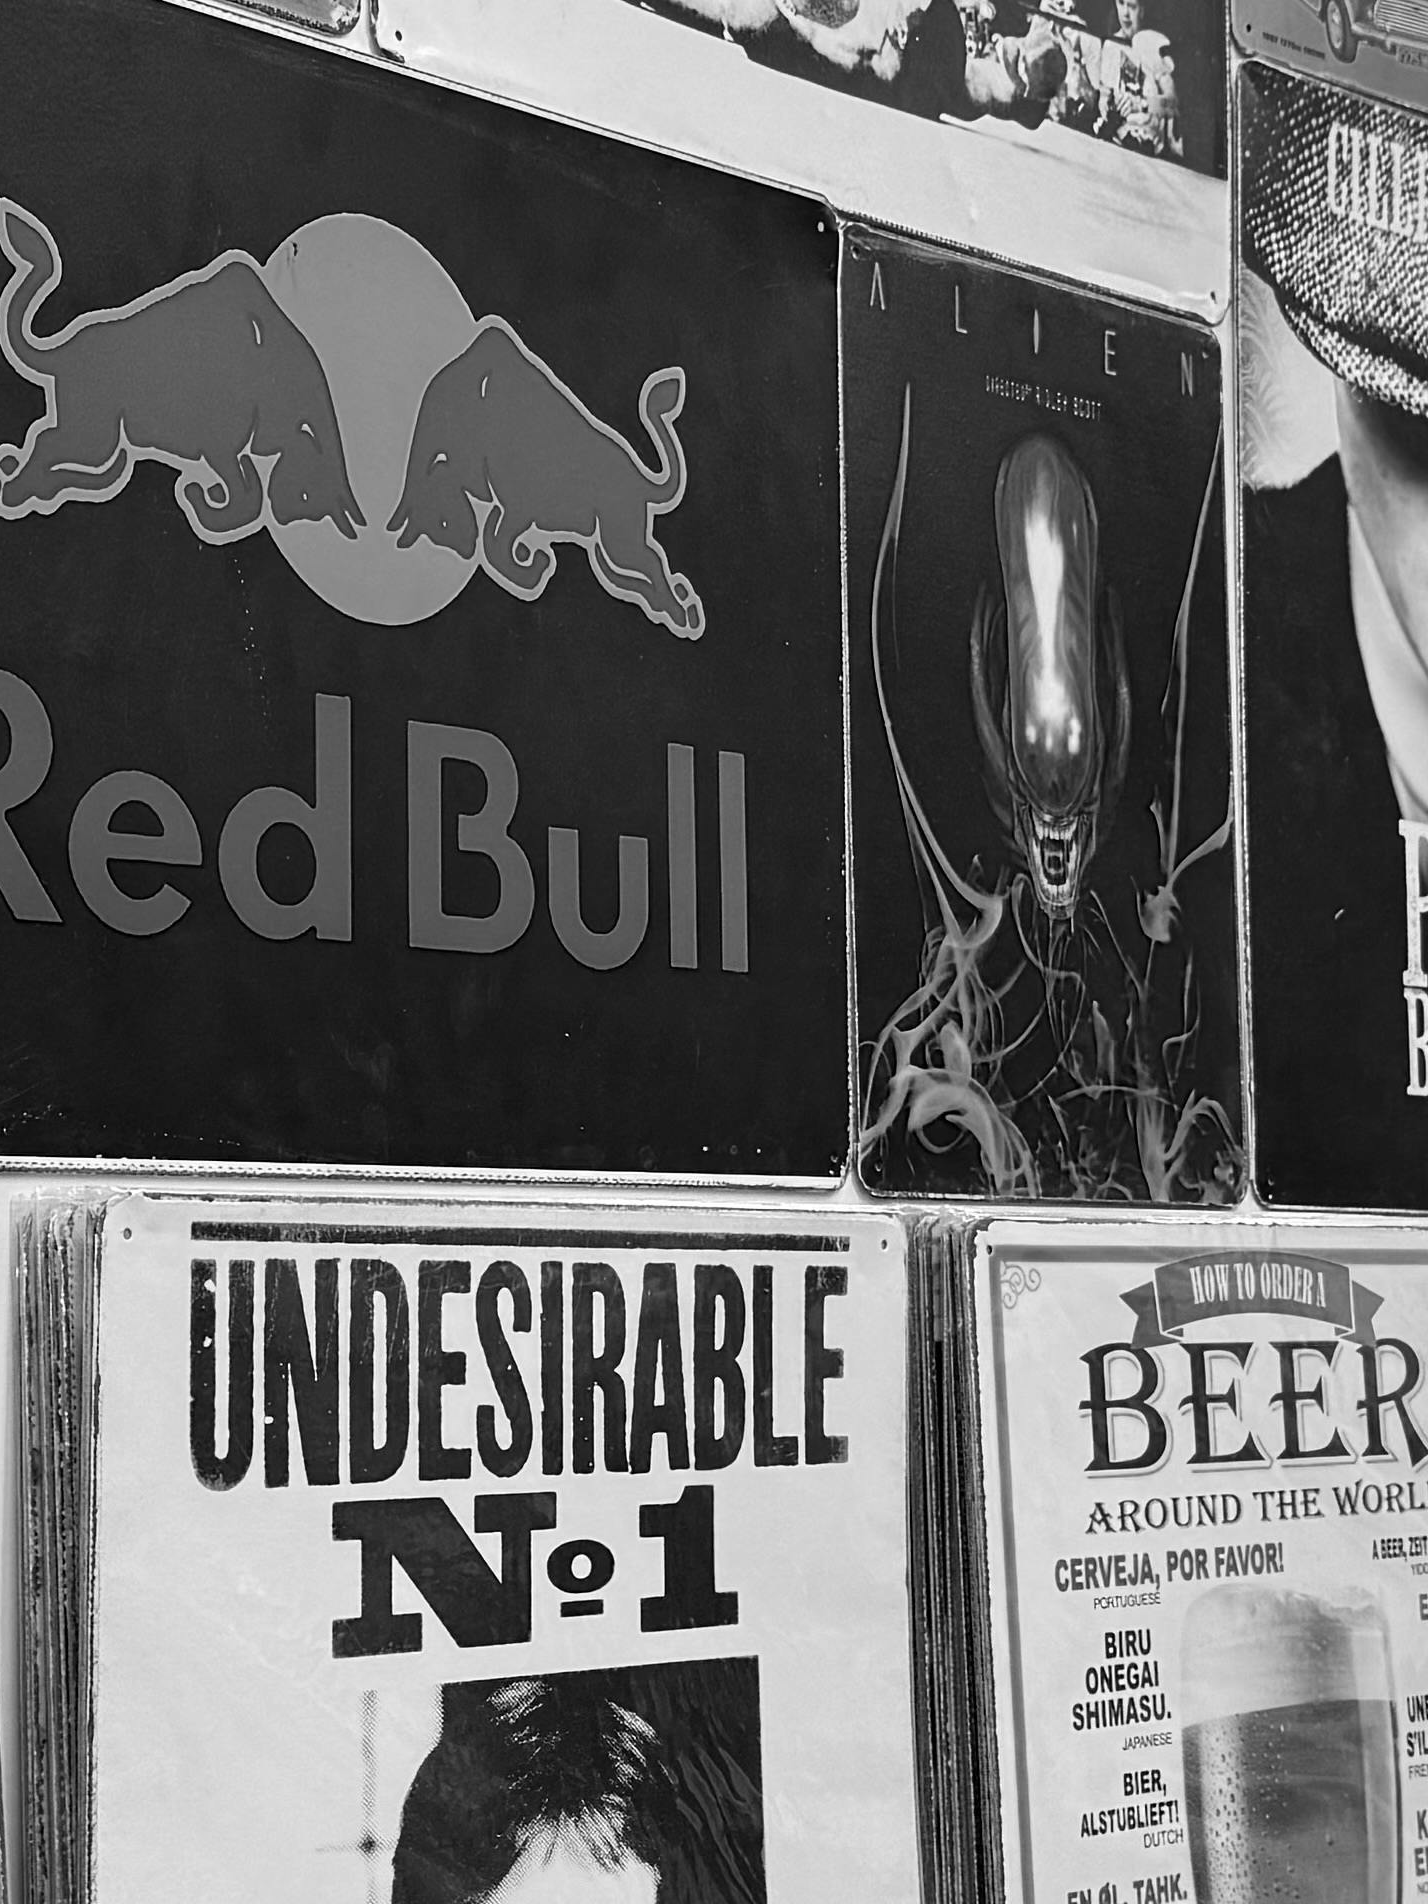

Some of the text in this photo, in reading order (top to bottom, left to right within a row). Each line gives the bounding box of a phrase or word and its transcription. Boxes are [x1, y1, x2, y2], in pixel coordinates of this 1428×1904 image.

[408, 719, 748, 975] Bull
[190, 1258, 850, 1492] UNDESIRABLE
[1085, 1494, 1242, 1534] AROUND
[1253, 1488, 1321, 1523] THE
[1080, 1800, 1180, 1839] ALSTUBLIEFT!
